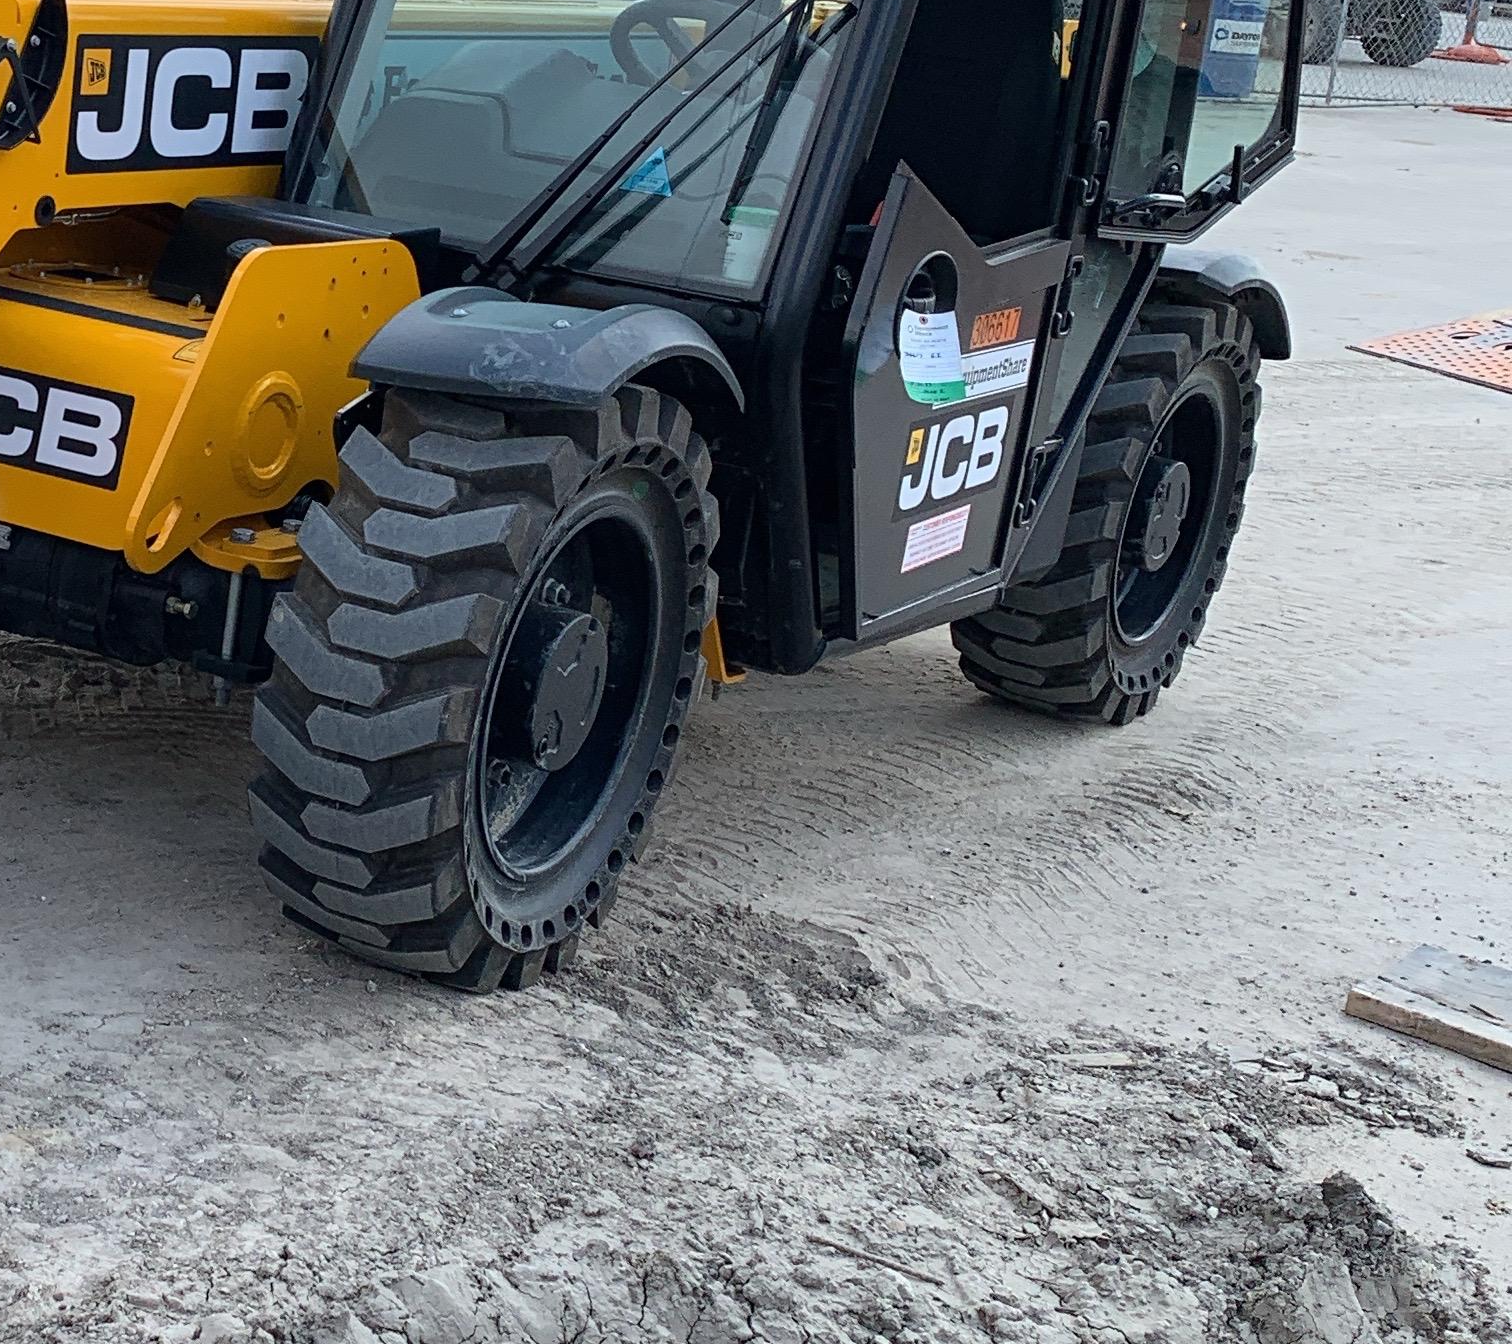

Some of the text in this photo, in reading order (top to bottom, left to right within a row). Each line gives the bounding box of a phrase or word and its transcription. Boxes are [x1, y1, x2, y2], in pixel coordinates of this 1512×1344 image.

[77, 47, 308, 160] JCB
[963, 357, 1028, 390] uipmentShare
[899, 405, 1009, 512] JCB
